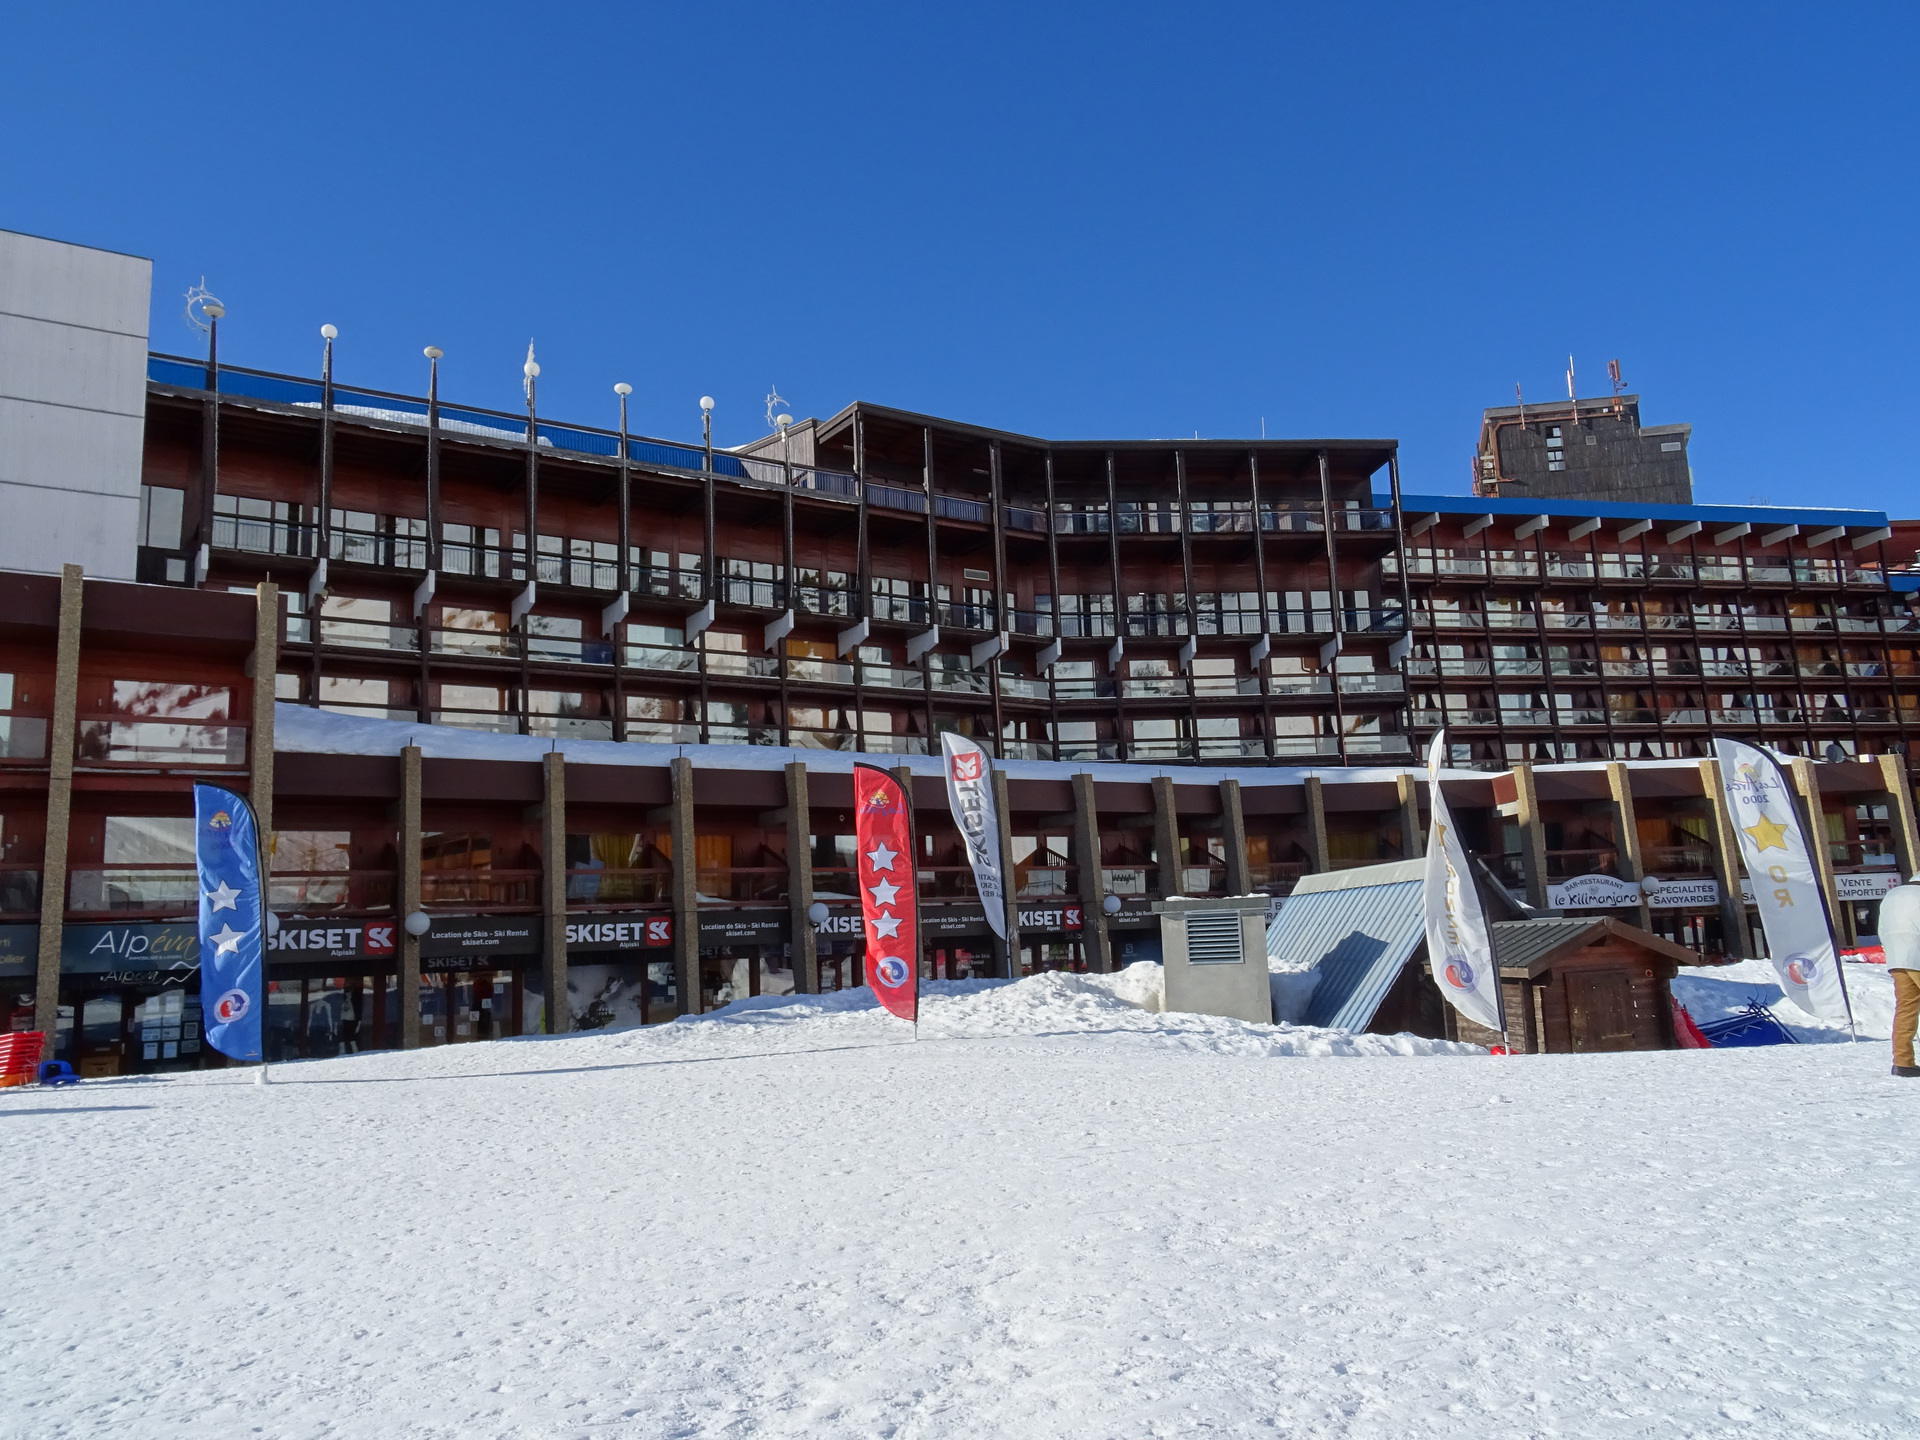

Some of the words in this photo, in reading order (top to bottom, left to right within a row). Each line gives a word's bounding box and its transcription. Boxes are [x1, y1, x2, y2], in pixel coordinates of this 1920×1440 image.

[1564, 878, 1624, 892] BAR-RESTAURANT
[1841, 878, 1872, 887] VENTE
[1837, 888, 1887, 897] EMPORTER
[1653, 895, 1716, 904] SAVOYARDES
[701, 923, 726, 931] Location
[734, 922, 747, 930] Skis
[761, 921, 779, 929] Rental
[431, 931, 462, 939] Location
[473, 930, 489, 938] Skis
[506, 929, 529, 937] Rental
[566, 922, 645, 943] SKISET
